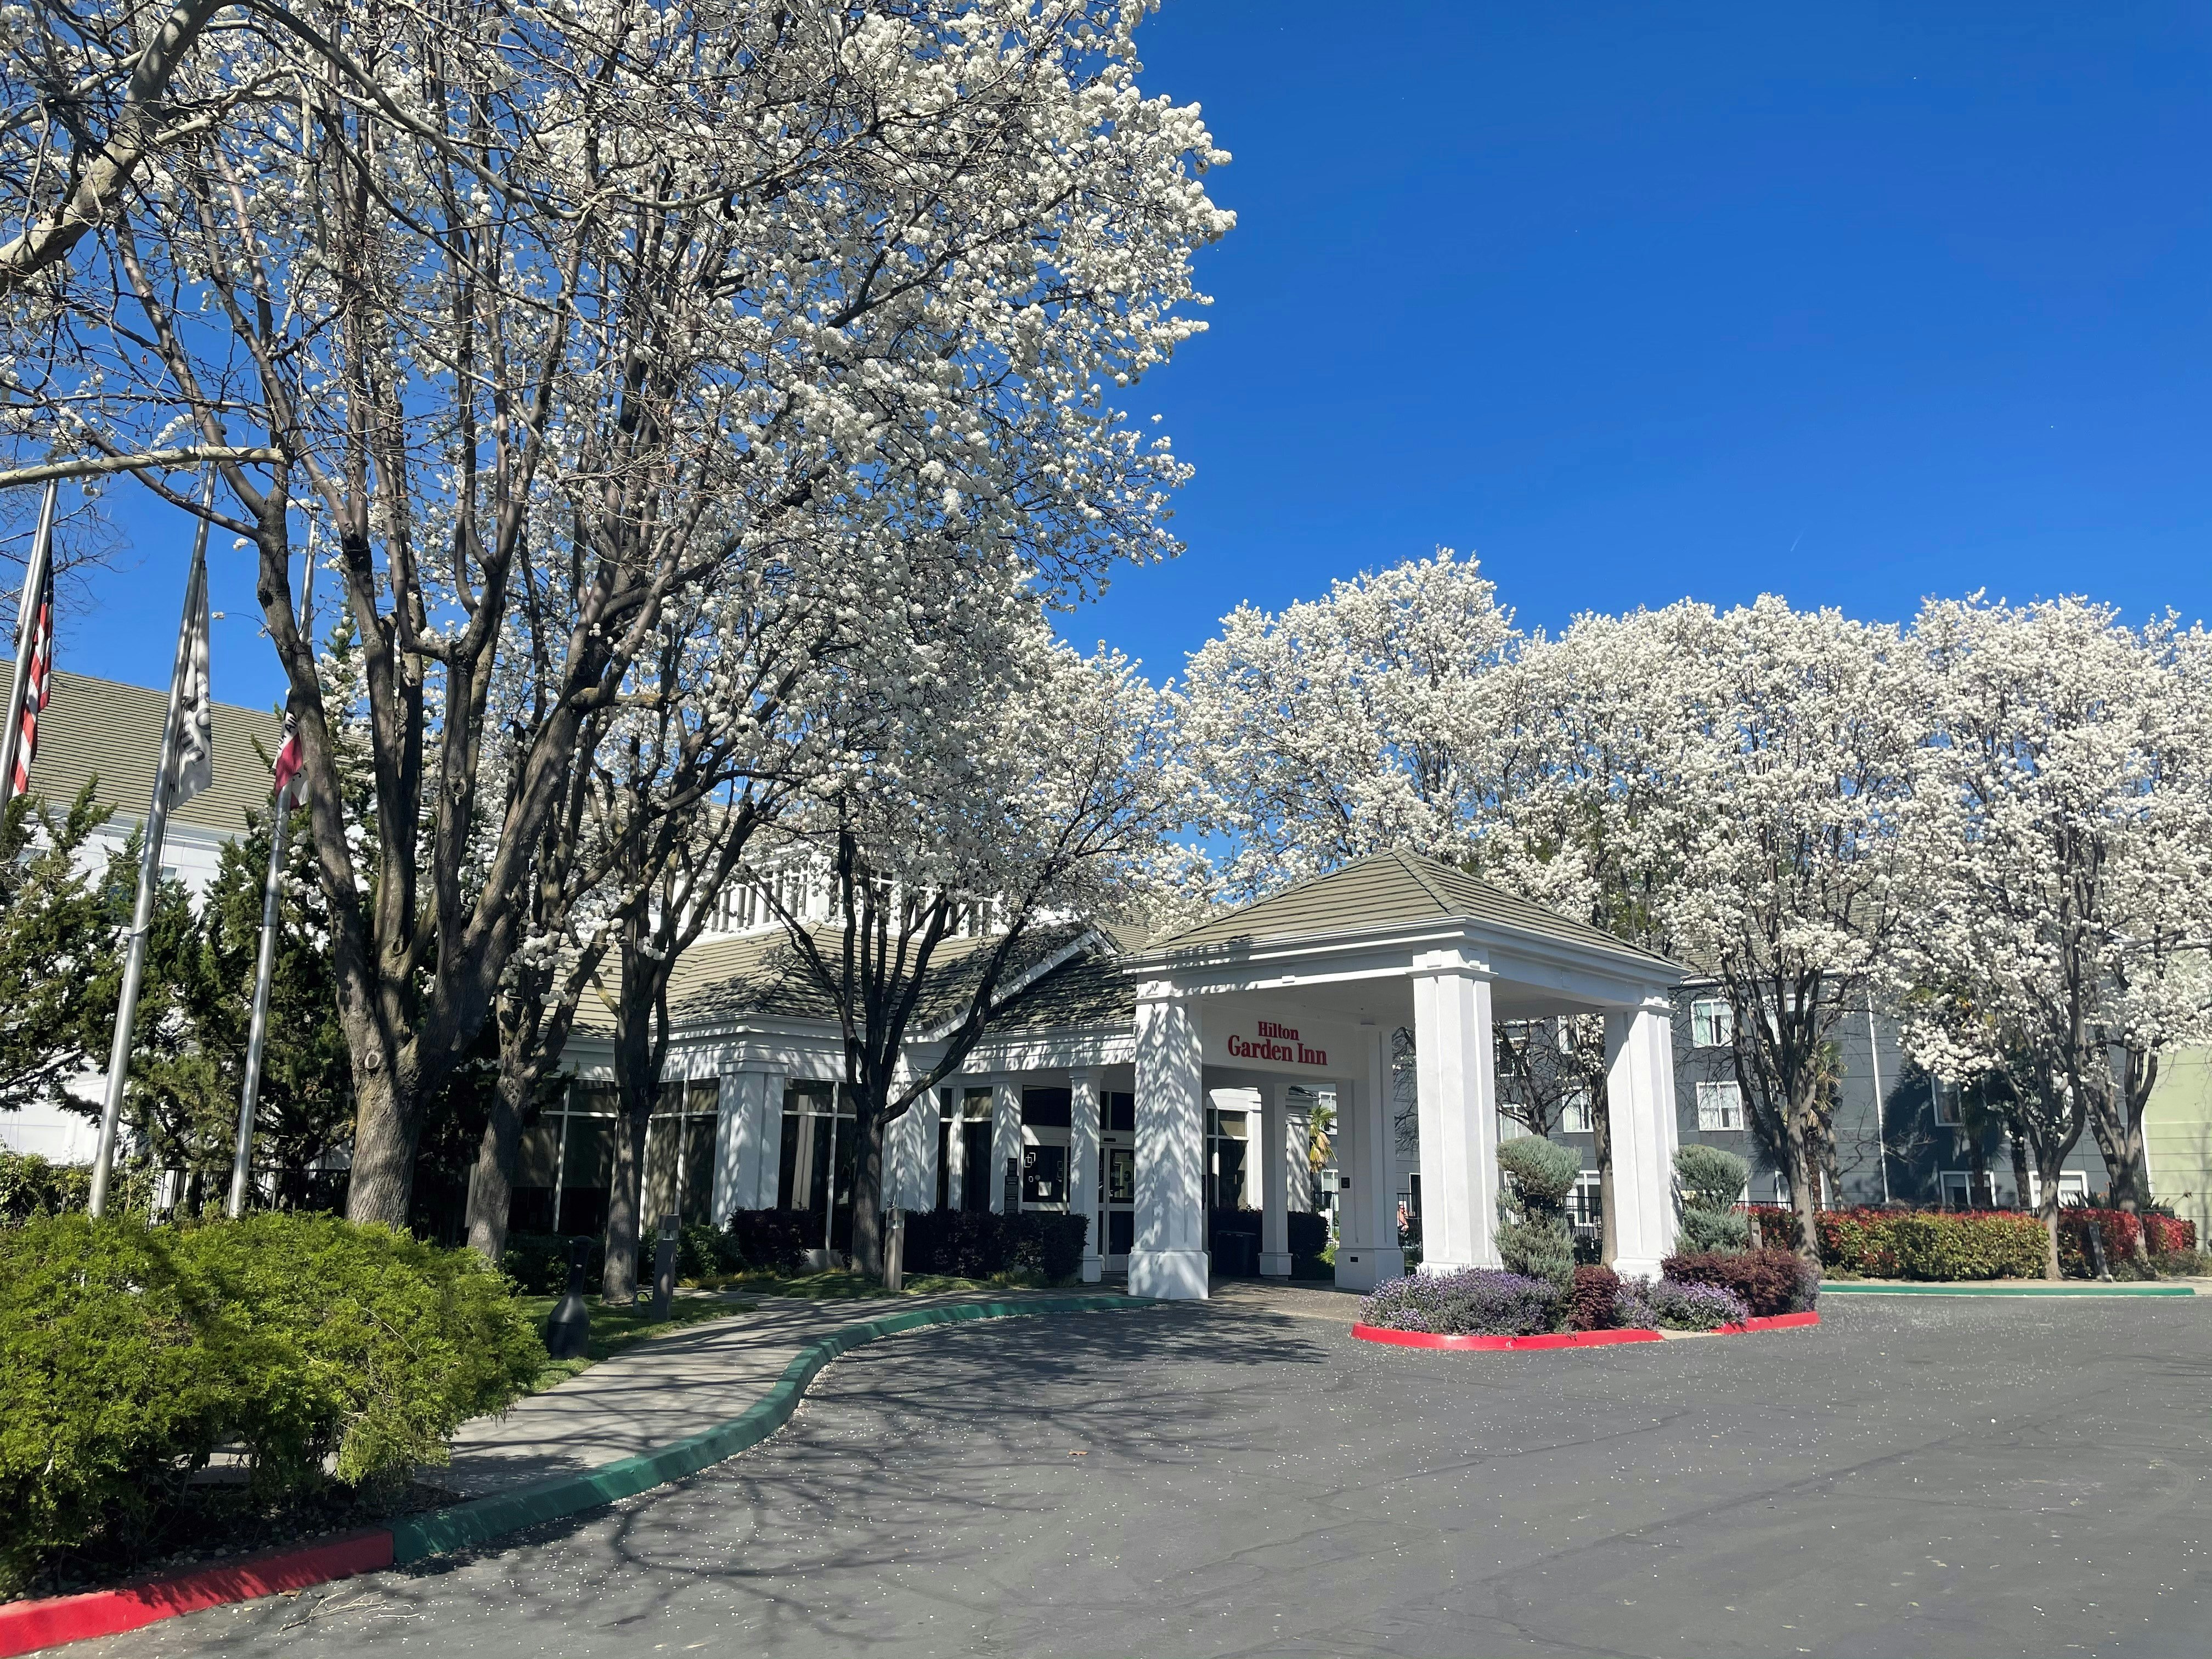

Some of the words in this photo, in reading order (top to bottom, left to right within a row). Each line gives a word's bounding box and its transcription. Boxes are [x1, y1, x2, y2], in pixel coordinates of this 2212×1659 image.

[1258, 1021, 1300, 1041] Hilton
[1228, 1035, 1294, 1062] Garden
[1297, 1043, 1328, 1065] Inn
